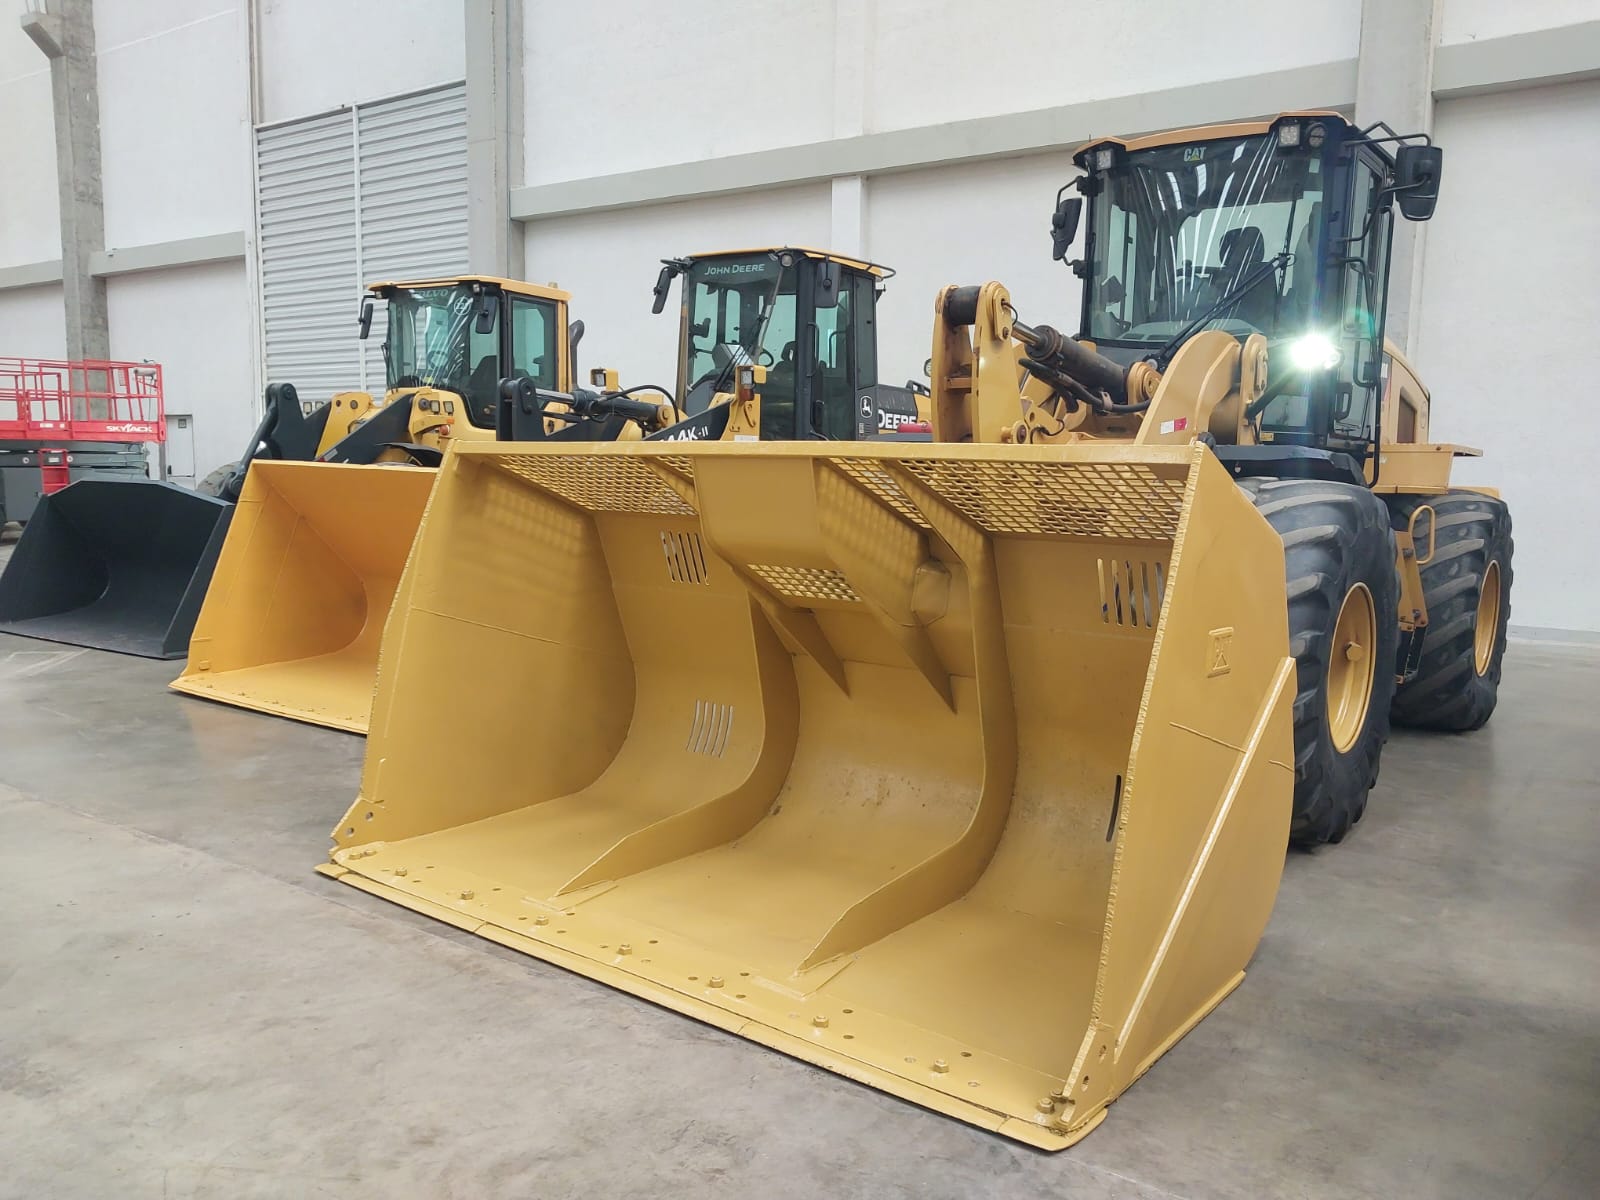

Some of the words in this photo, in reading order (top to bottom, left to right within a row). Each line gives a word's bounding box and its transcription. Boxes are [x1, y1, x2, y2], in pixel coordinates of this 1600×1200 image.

[1184, 147, 1207, 161] CAT
[704, 266, 730, 276] JOHN
[731, 264, 766, 274] DEERE
[106, 423, 153, 433] SKYJACK
